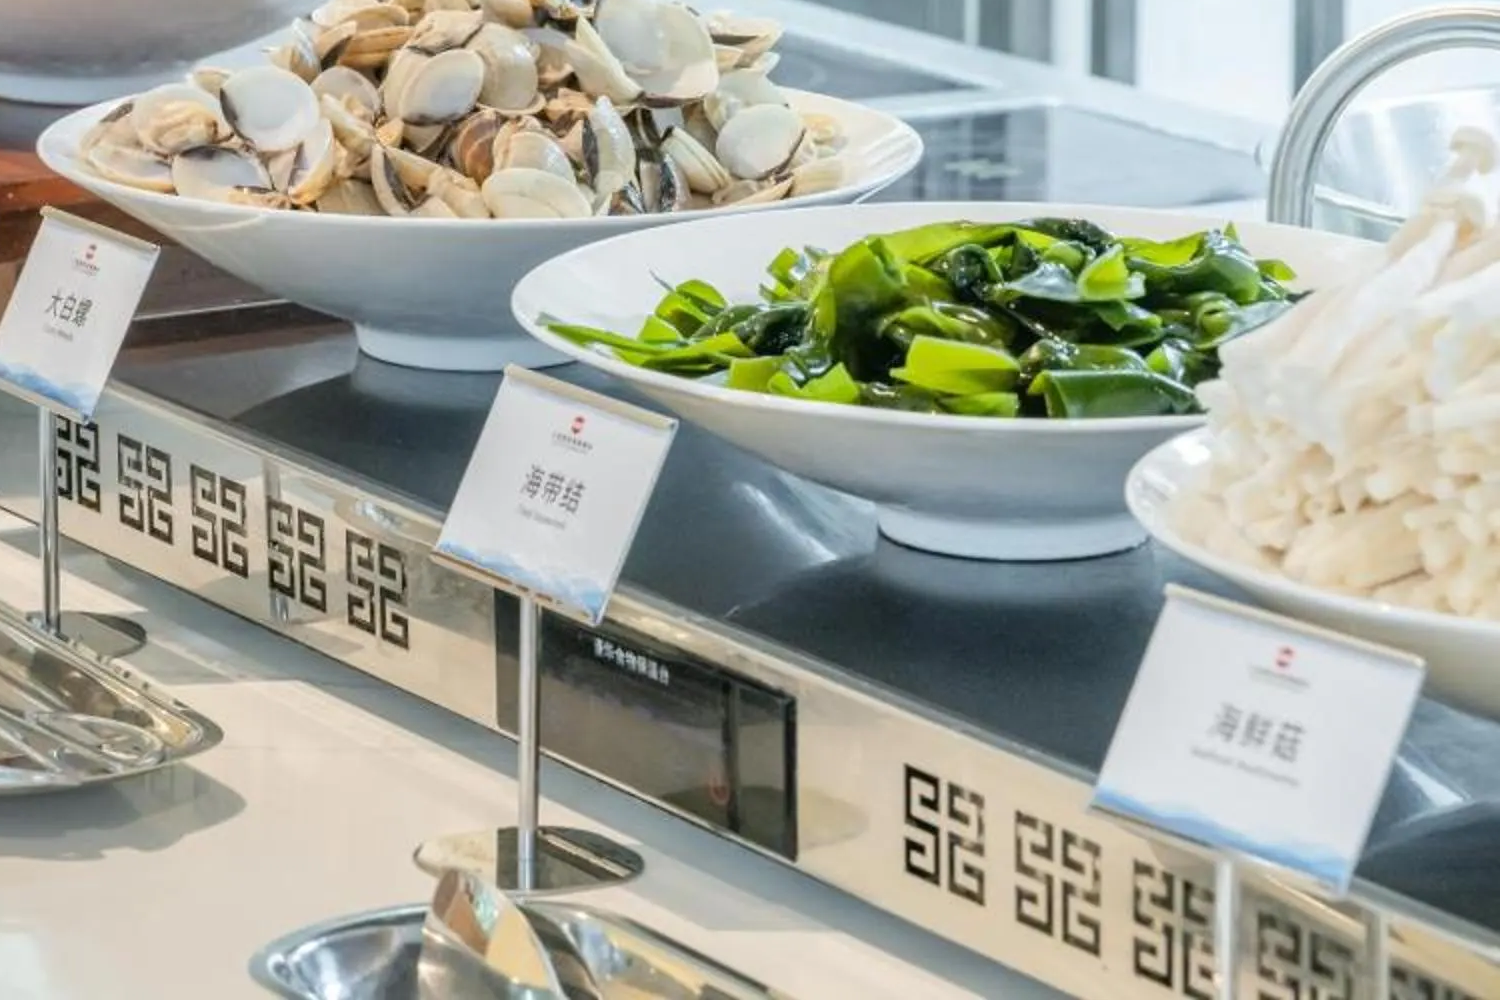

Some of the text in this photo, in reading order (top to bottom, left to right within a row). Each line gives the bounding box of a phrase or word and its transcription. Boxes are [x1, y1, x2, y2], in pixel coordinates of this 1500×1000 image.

[44, 289, 93, 327] 大白螺
[520, 465, 586, 513] 海带结
[1207, 702, 1305, 763] 海鲜菇
